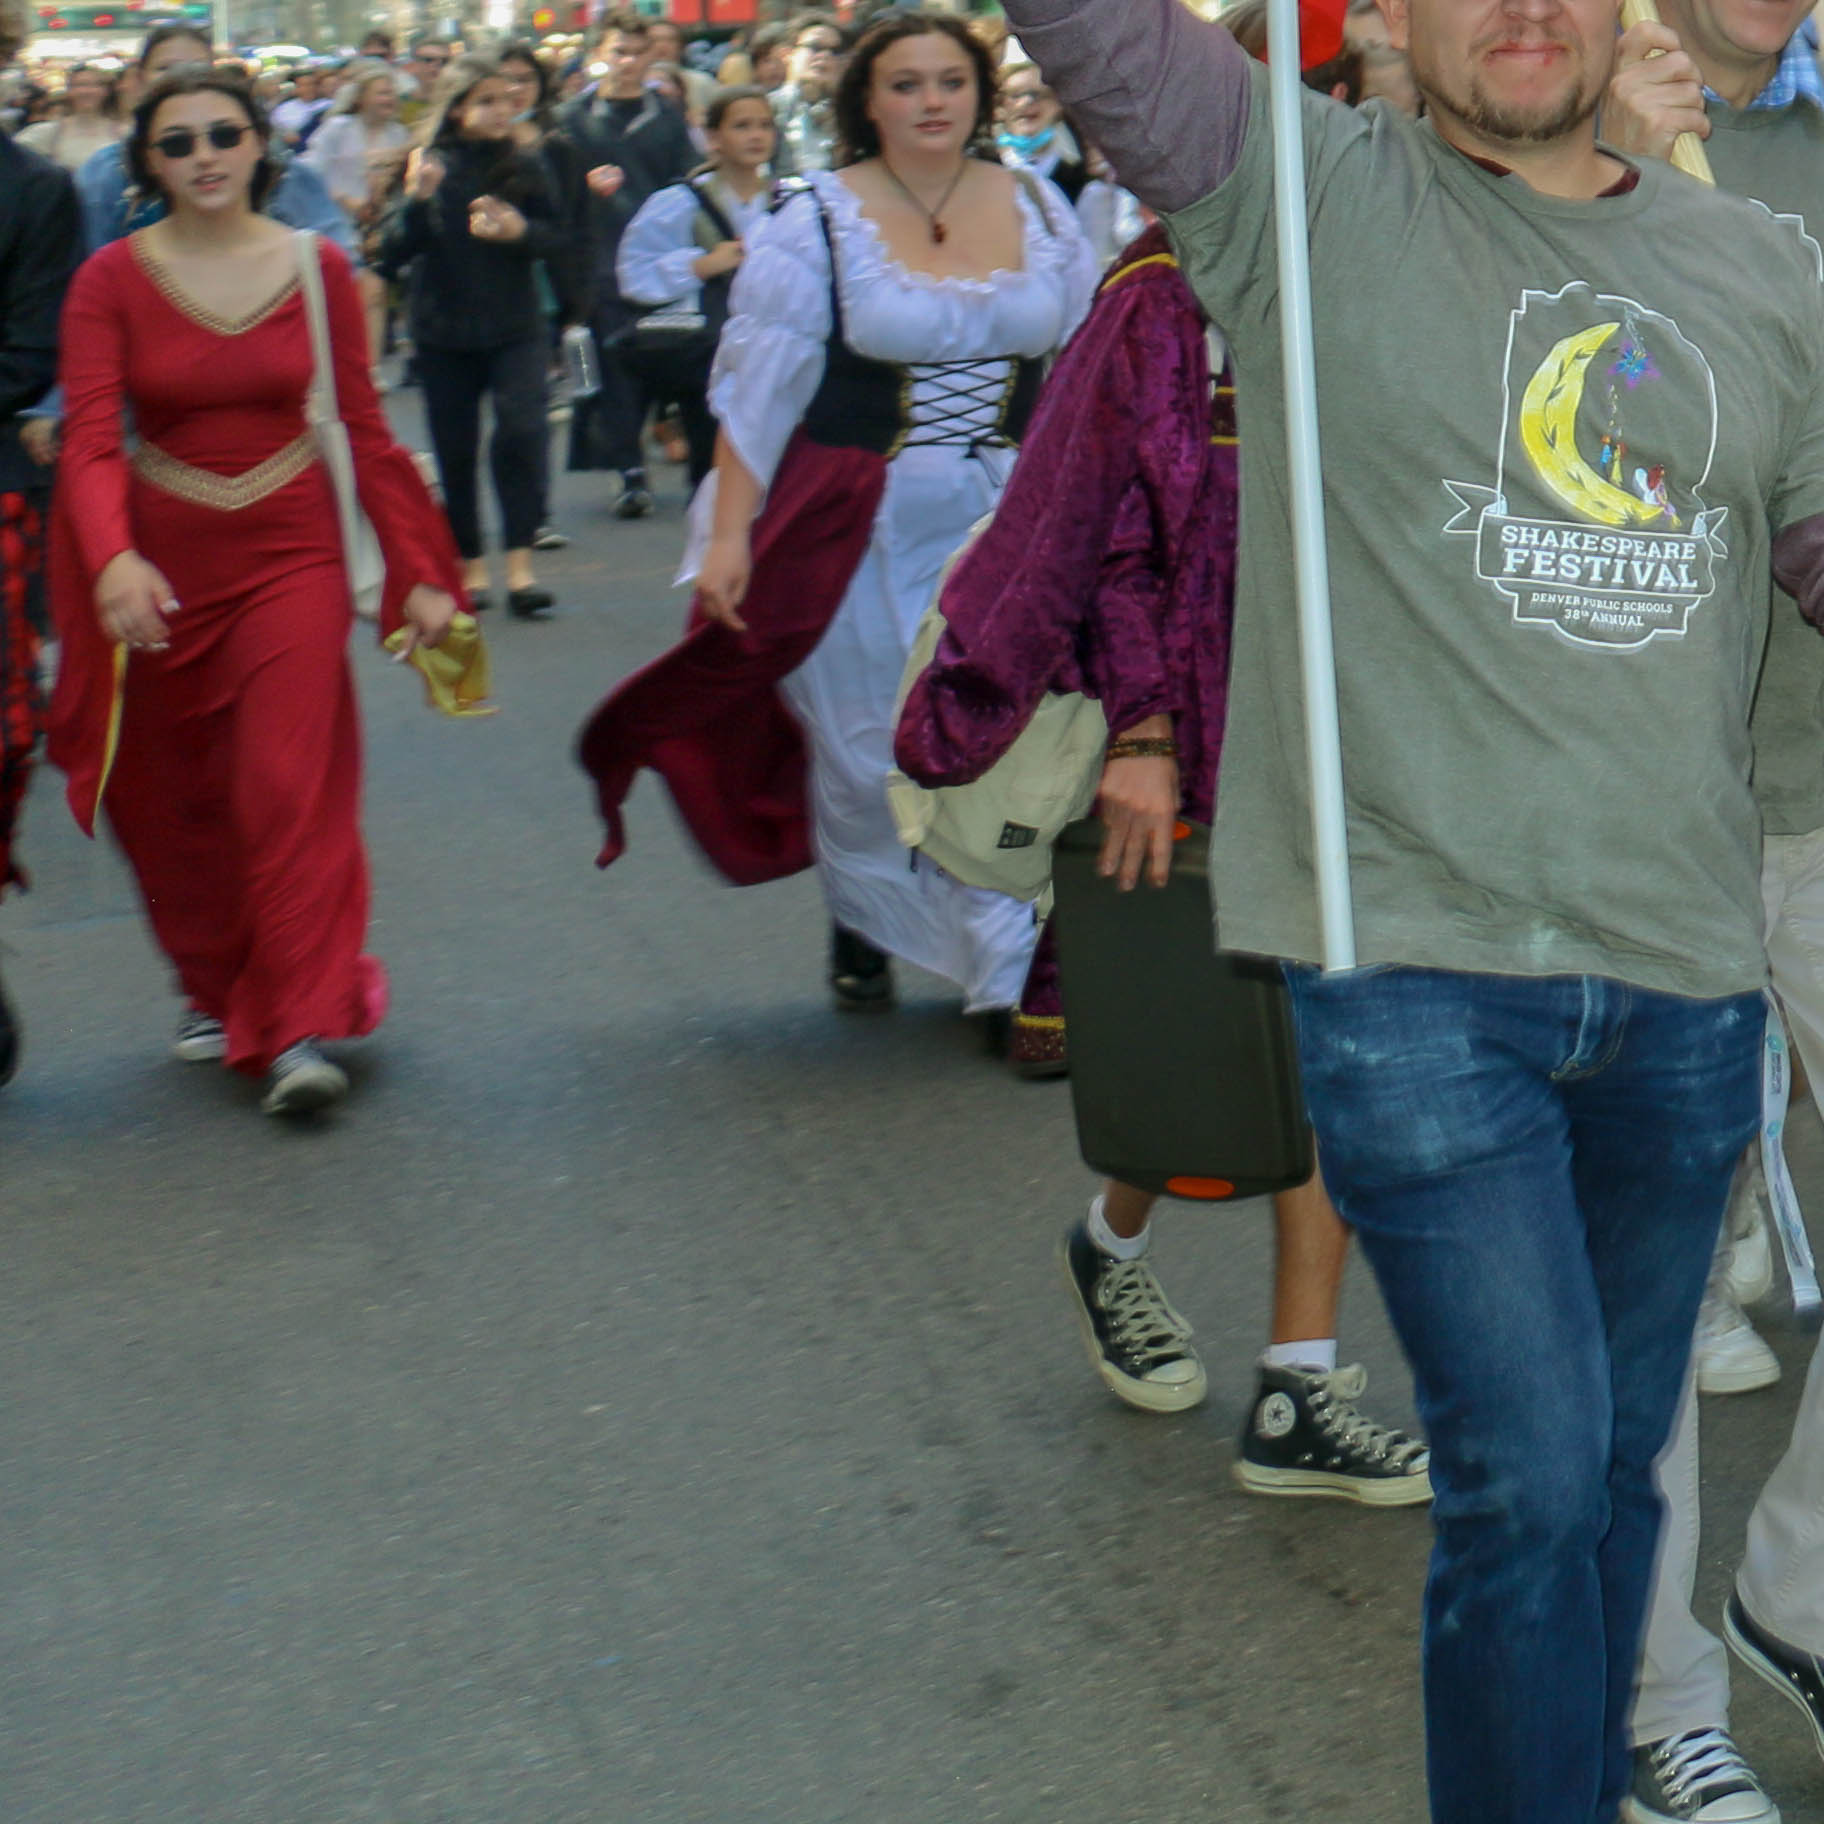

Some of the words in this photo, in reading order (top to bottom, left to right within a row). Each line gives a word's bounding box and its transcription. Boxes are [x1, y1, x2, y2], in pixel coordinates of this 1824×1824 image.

[1501, 526, 1696, 560] SHAKESPEARE
[1503, 548, 1698, 588] FESTIVAL
[1531, 592, 1581, 605] DENVER
[1583, 597, 1620, 611] PUBLIC
[1623, 601, 1673, 614] SCHOOLS
[1591, 612, 1645, 627] ANNUAL
